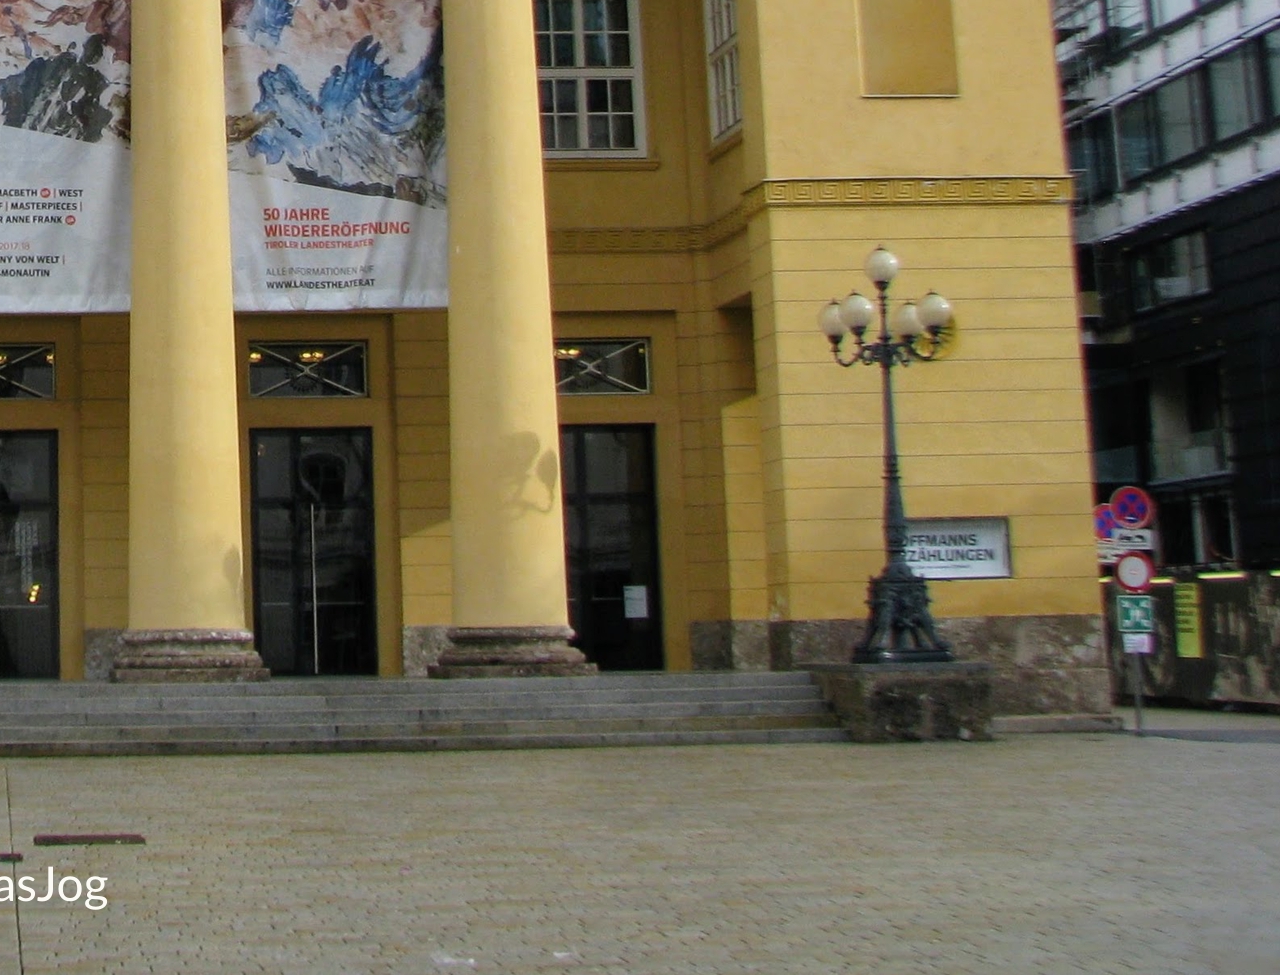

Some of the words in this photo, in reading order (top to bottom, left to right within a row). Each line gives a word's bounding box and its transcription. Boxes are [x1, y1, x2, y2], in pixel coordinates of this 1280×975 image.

[58, 188, 84, 198] WEST
[10, 202, 78, 211] MASTERPIECES
[6, 215, 31, 224] ANNE
[33, 215, 63, 224] FRANK
[263, 207, 280, 221] 50
[283, 207, 330, 221] JAHRE
[263, 221, 411, 237] WIEDERERÖFFNUNG
[264, 240, 299, 250] TIROLER
[300, 238, 375, 250] LANDESTHEATER
[14, 255, 35, 264] VON
[36, 255, 60, 264] WELT
[265, 267, 288, 277] ALLE
[288, 266, 358, 277] INFORMATIONEN
[359, 264, 375, 274] AUF
